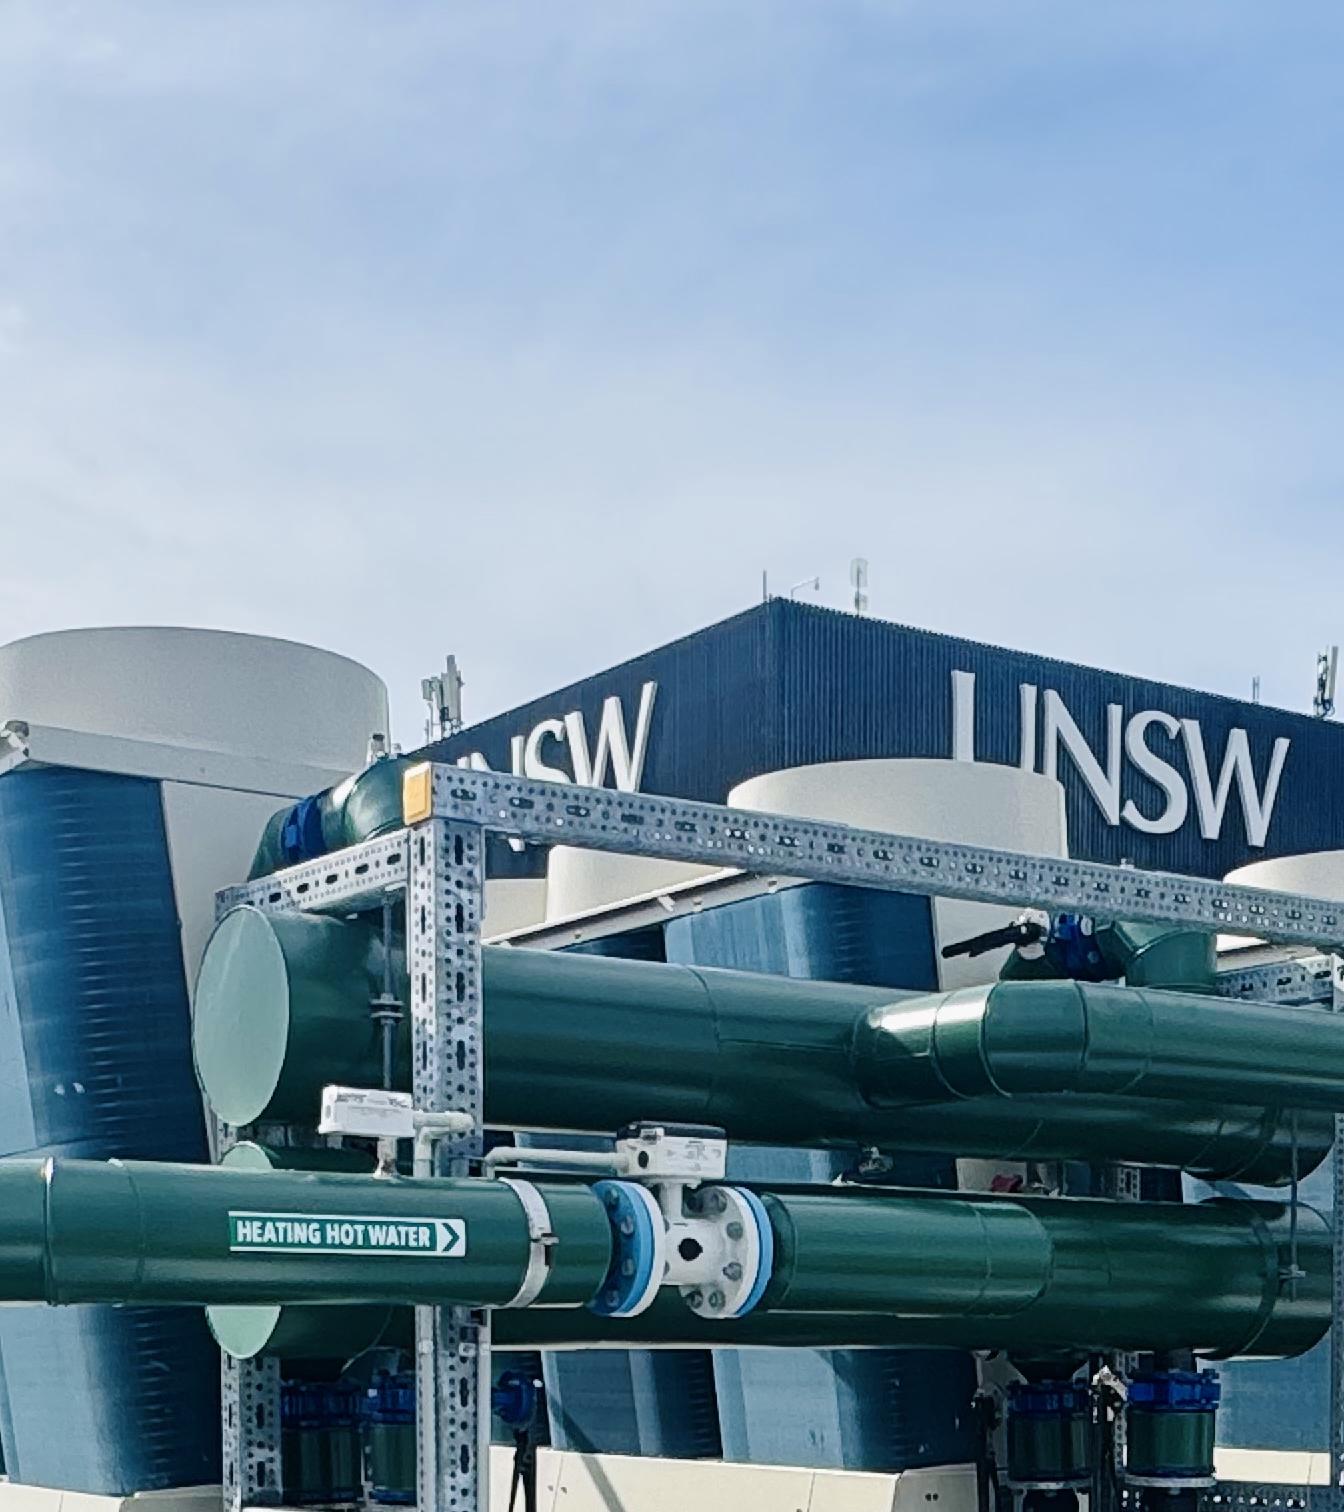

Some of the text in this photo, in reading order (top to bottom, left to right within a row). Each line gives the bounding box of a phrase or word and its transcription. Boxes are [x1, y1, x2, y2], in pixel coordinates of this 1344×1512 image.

[951, 669, 1291, 847] UNSW
[236, 1220, 431, 1248] HEATING HOT WATER
